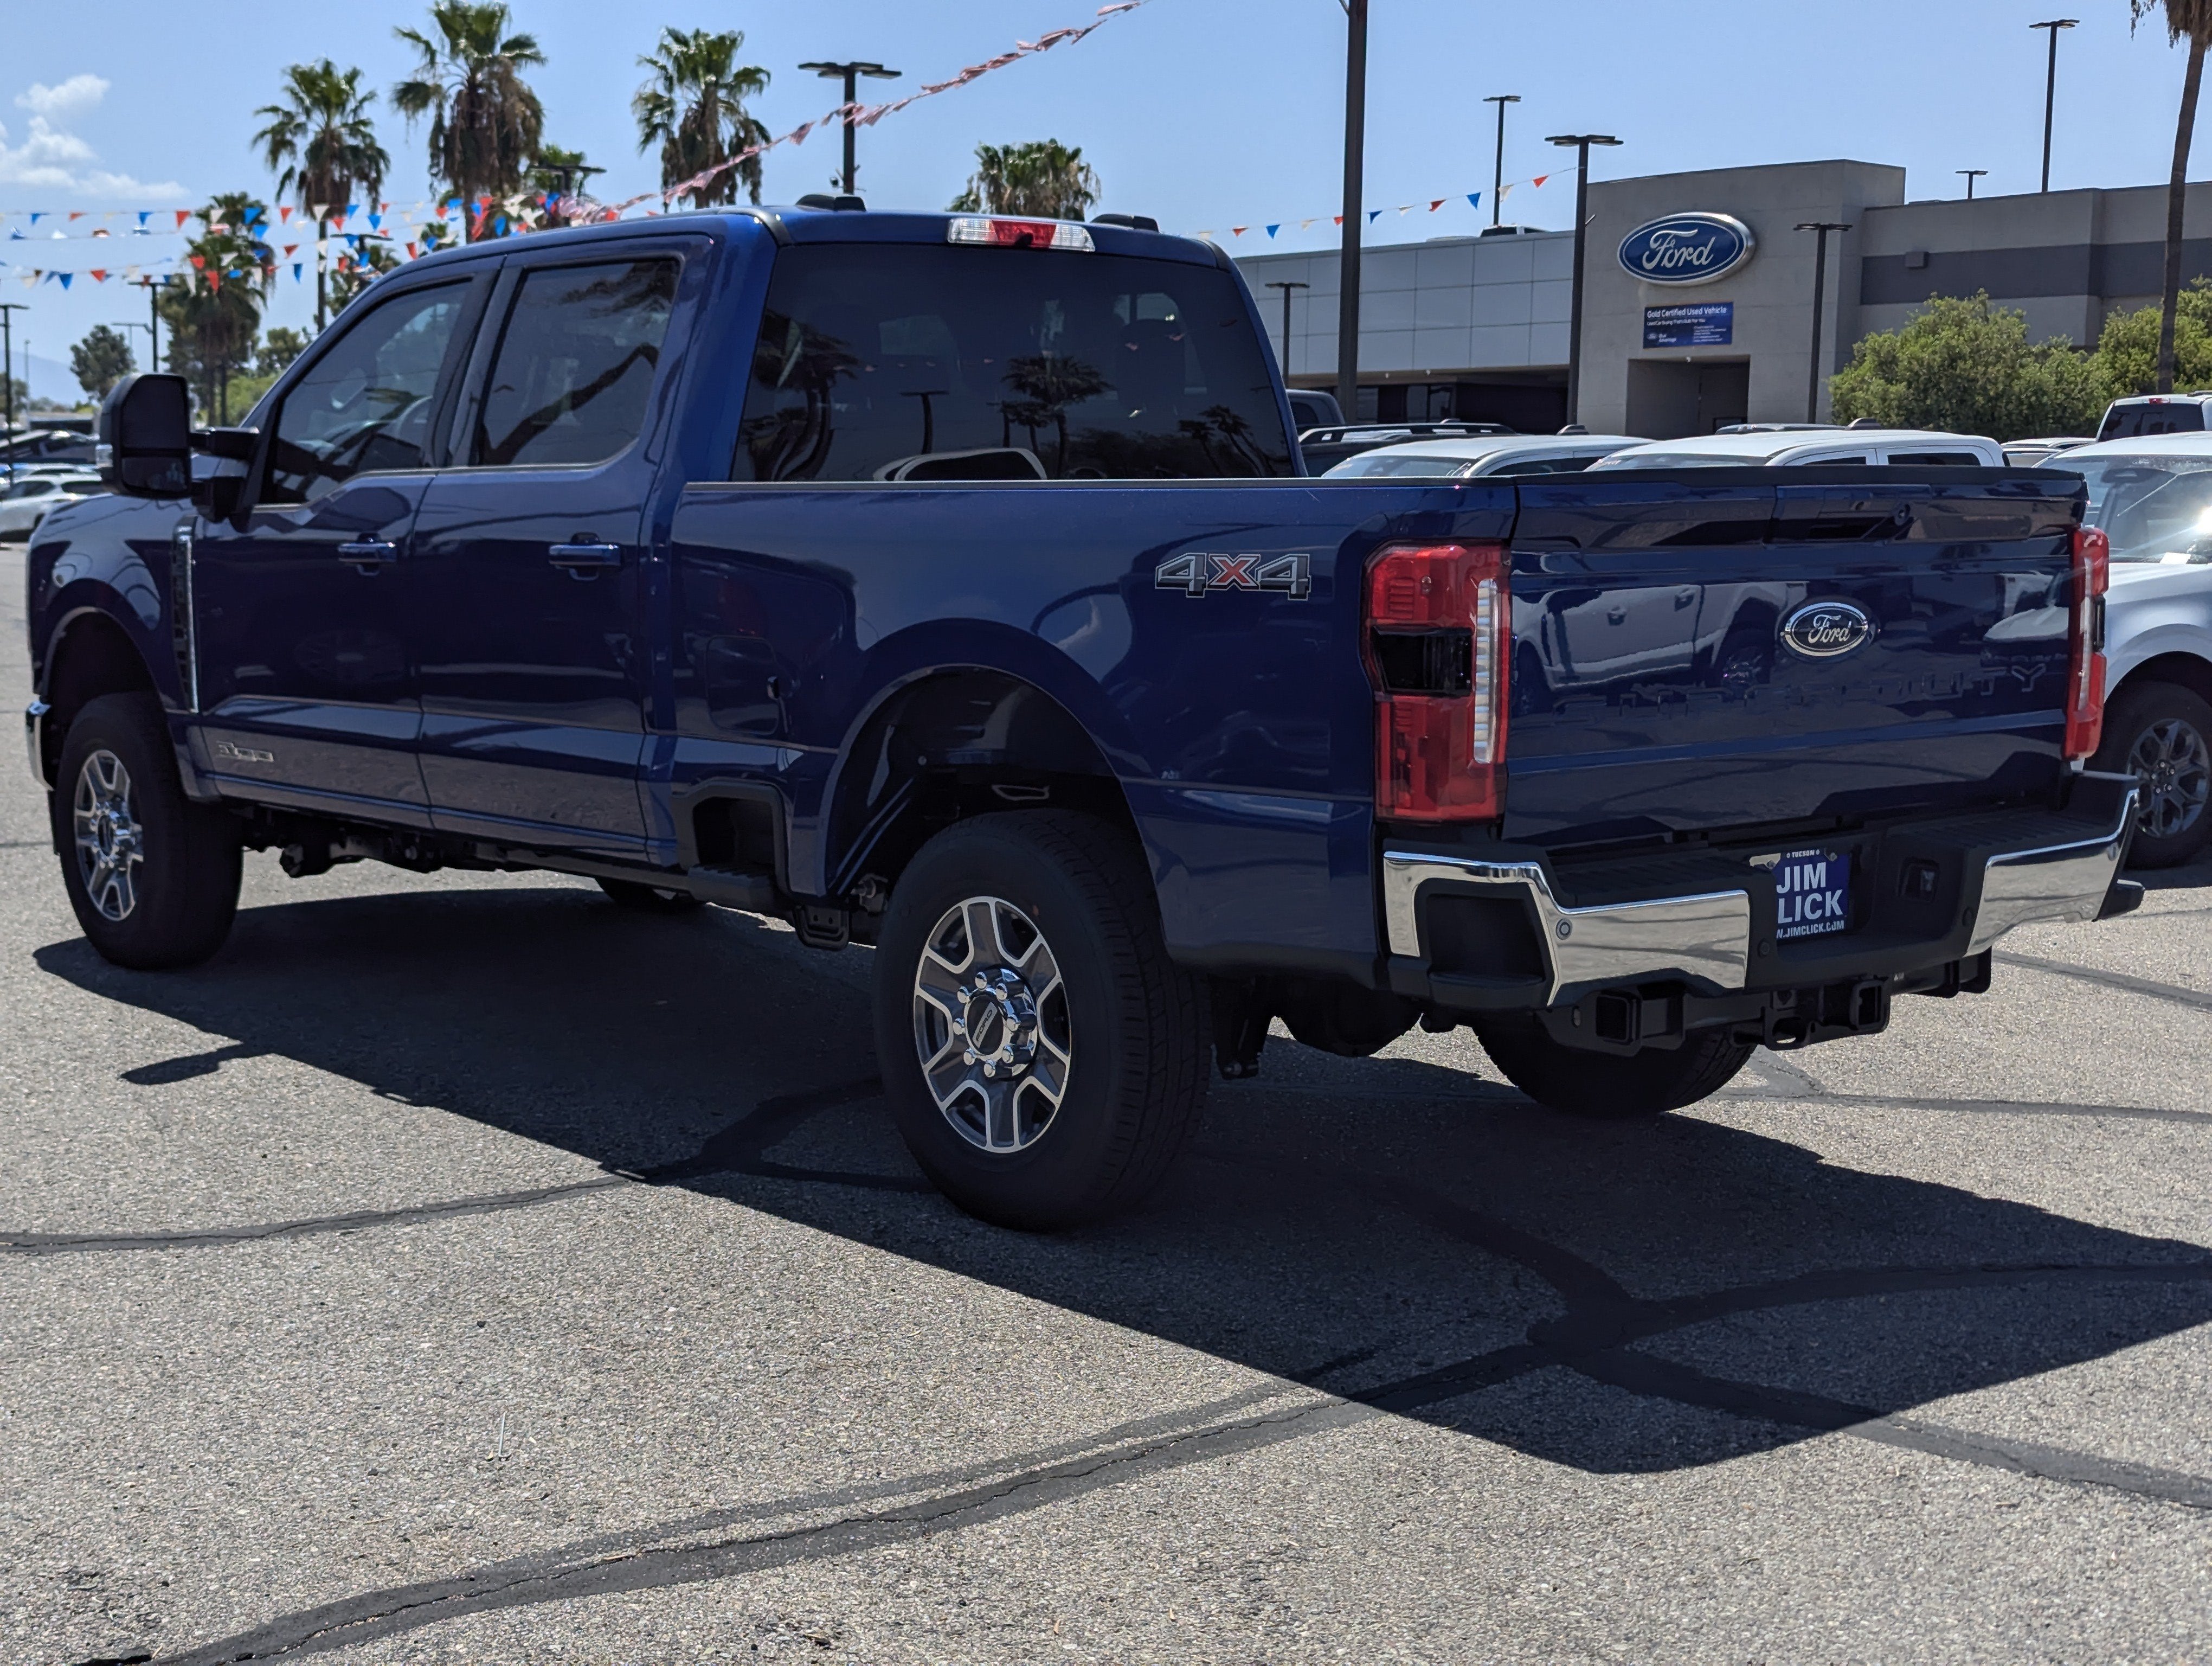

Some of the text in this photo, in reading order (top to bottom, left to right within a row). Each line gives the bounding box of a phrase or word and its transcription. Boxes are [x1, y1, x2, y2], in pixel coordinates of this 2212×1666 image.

[1642, 229, 1716, 270] Ford
[1647, 306, 1727, 318] Gold Certified Used Vehicle
[1808, 614, 1851, 644] Ford
[1792, 849, 1815, 858] TUCSON
[1776, 862, 1827, 894] JIM
[976, 1009, 993, 1042] FORD
